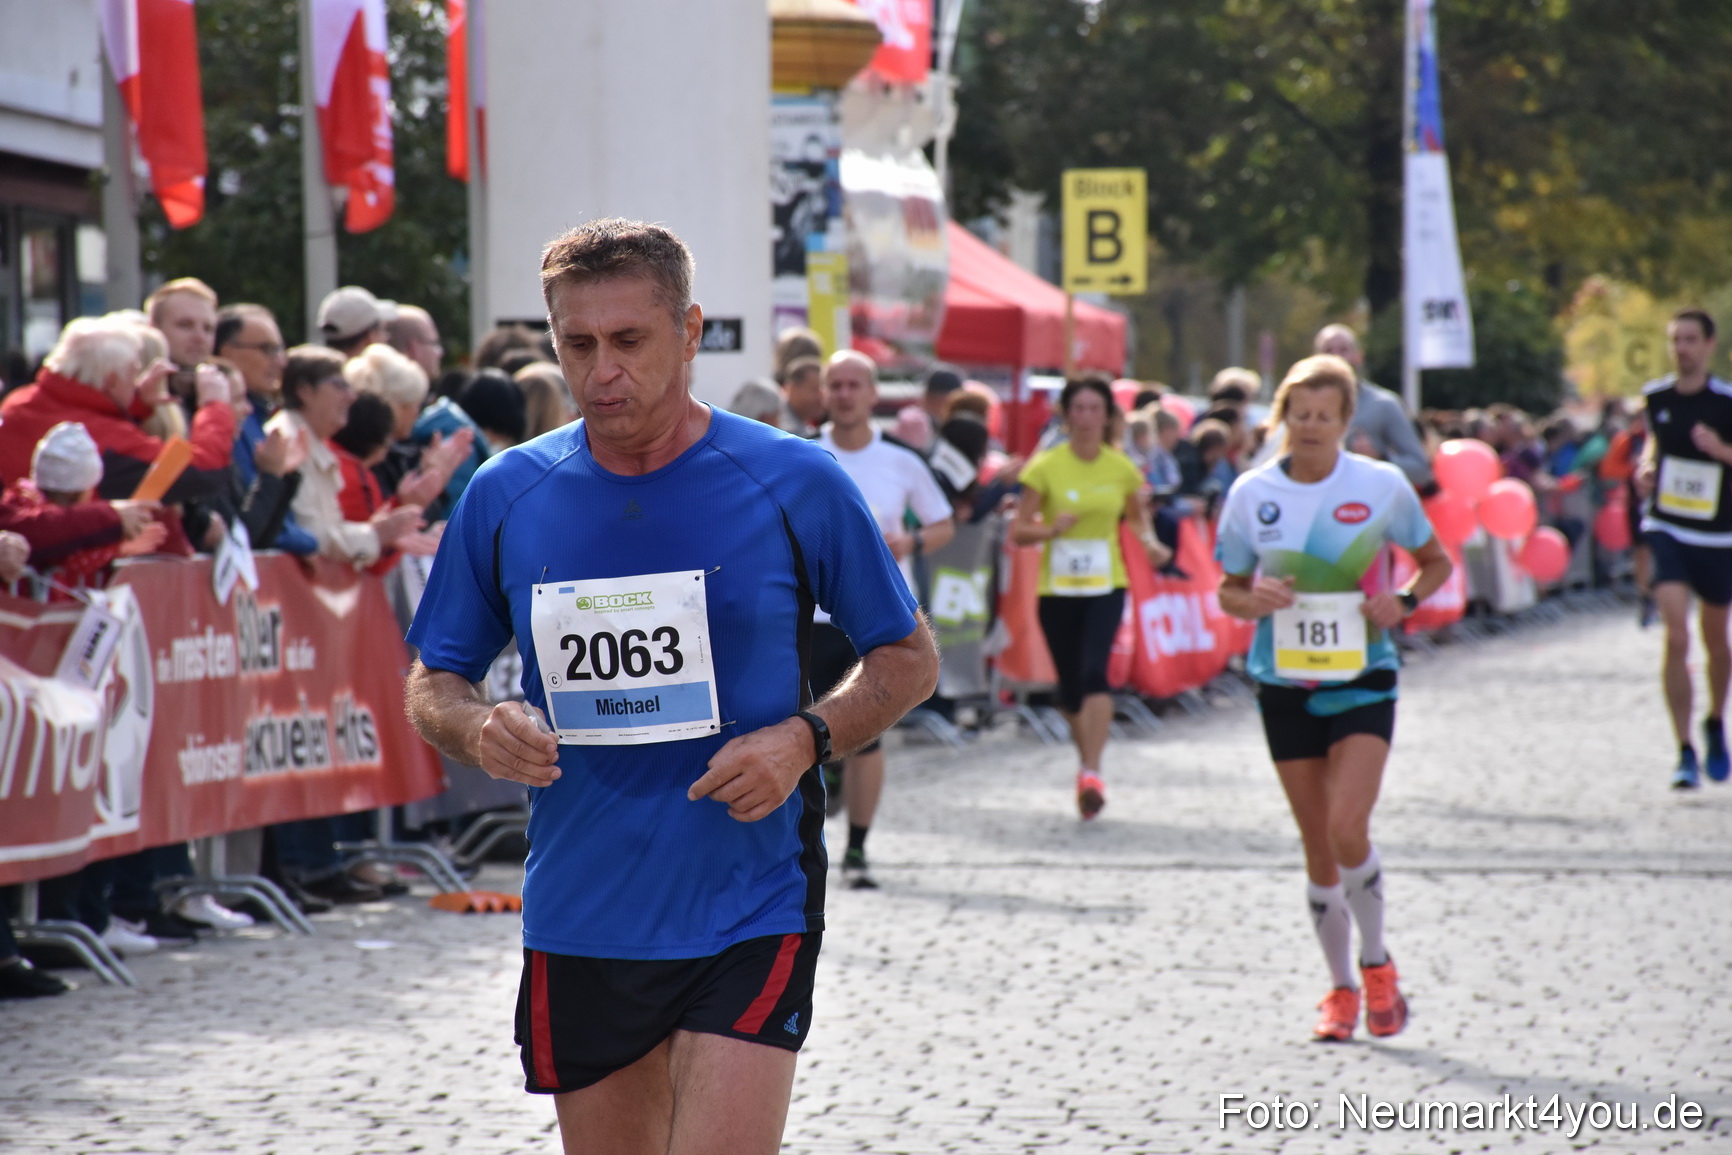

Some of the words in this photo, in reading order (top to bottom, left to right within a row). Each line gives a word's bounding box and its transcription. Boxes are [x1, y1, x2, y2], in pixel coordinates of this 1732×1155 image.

[1074, 175, 1137, 200] Block
[1086, 208, 1122, 264] B
[1625, 341, 1650, 375] C
[593, 591, 654, 609] BOCK
[1296, 620, 1339, 646] 181
[560, 626, 684, 681] 2063
[595, 695, 661, 716] Michael
